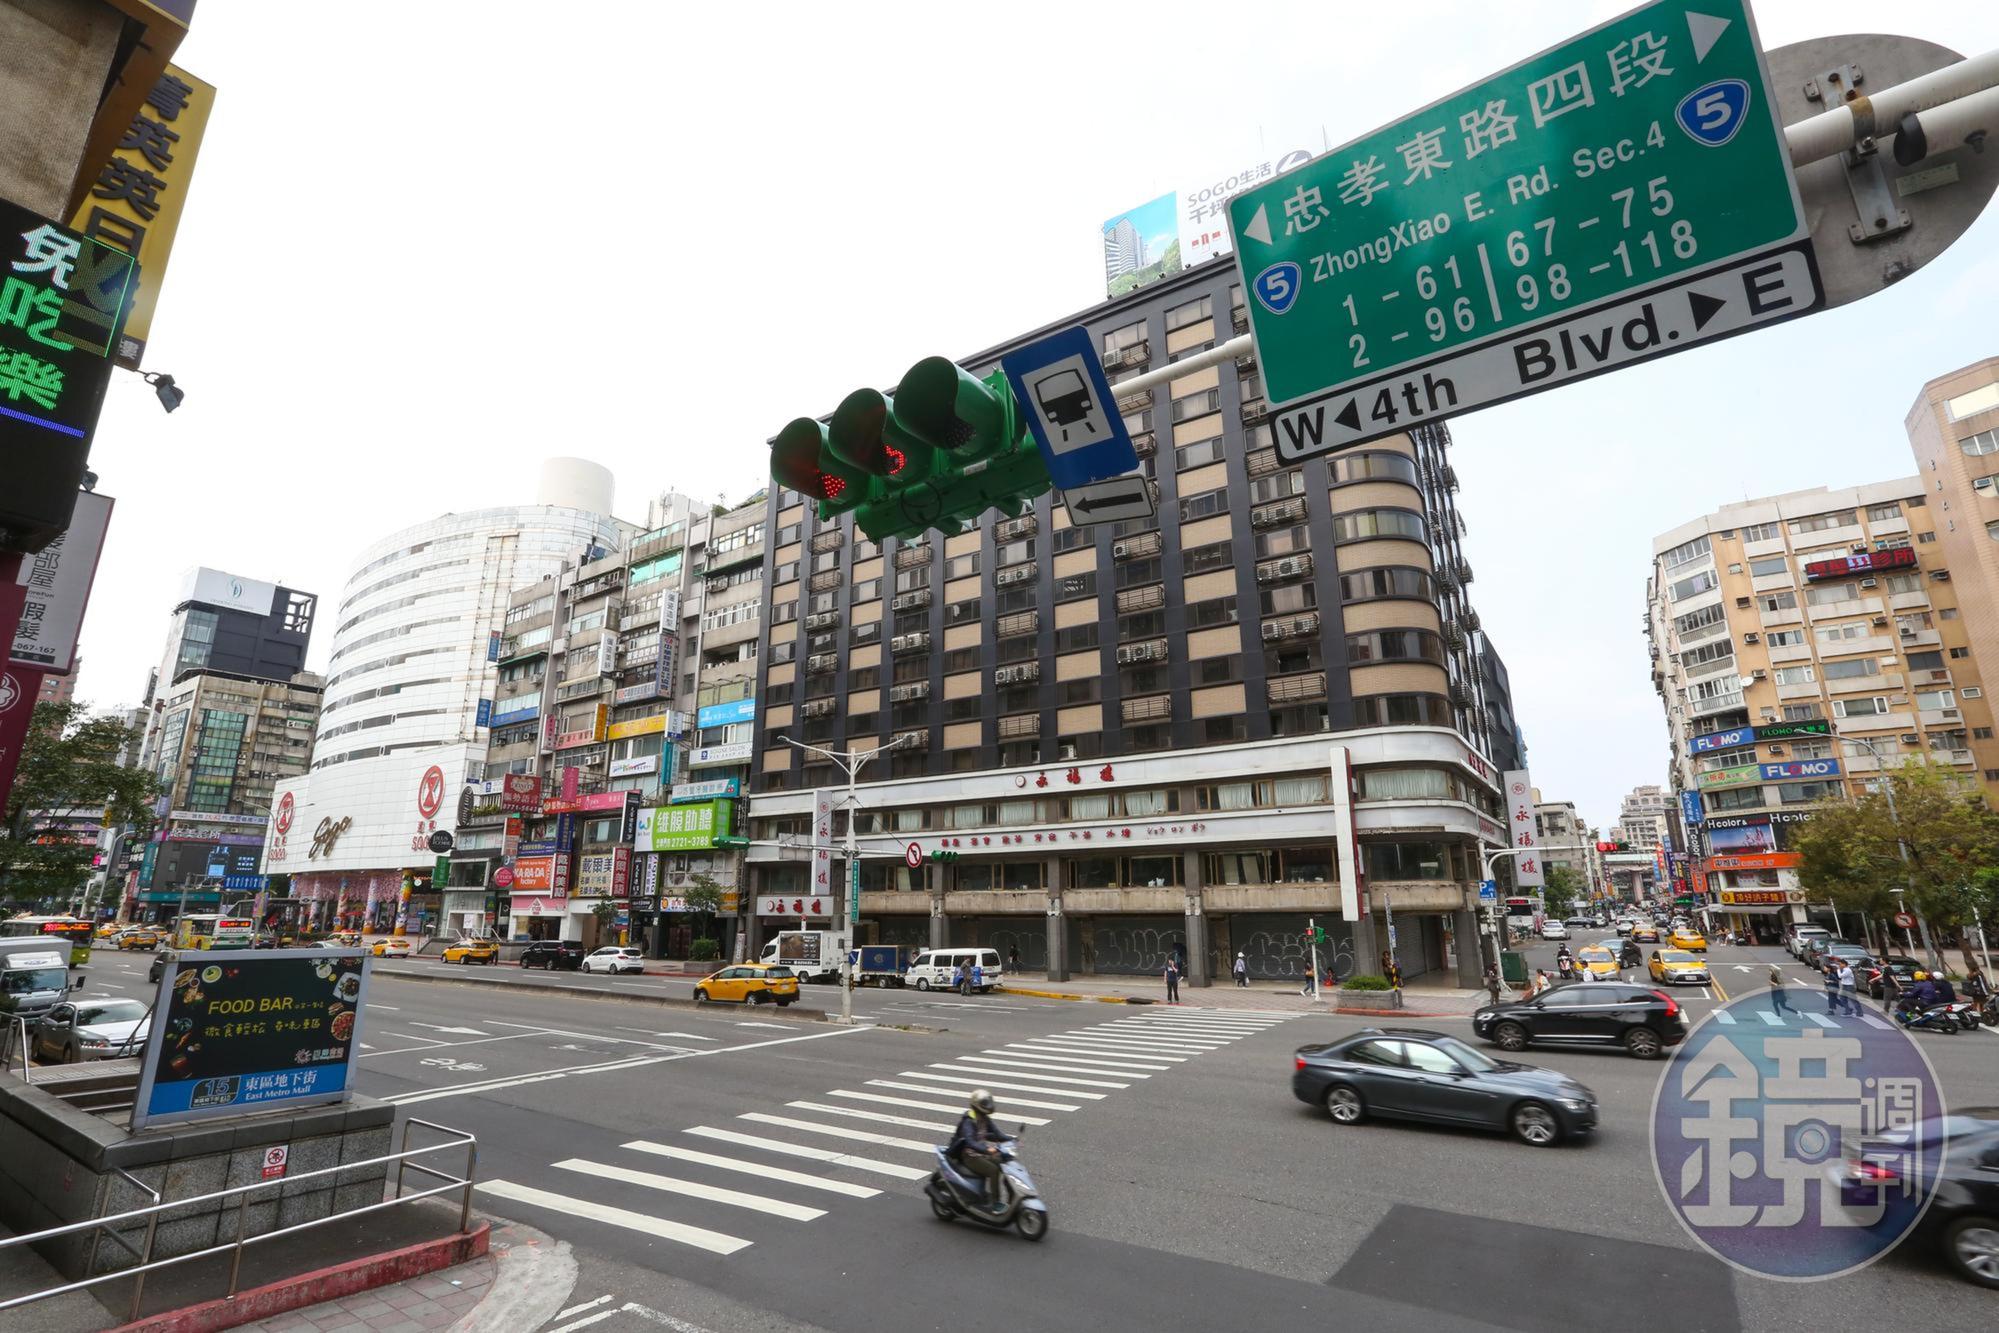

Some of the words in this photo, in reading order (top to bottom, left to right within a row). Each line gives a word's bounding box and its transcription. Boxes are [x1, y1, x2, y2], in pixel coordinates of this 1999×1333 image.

[1696, 91, 1733, 130] 5
[1283, 31, 1675, 237] 忠孝東路四段
[1309, 211, 1451, 284] ZhongXiao
[1463, 192, 1495, 223] E.
[1506, 165, 1559, 205] Rd.
[1572, 120, 1666, 178] Sec.4
[1342, 294, 1359, 326] 1
[1415, 254, 1463, 301] 61
[1506, 217, 1557, 267] 67
[1611, 176, 1675, 229] 75
[1265, 271, 1290, 301] 5
[1348, 333, 1371, 369] 2
[1424, 296, 1476, 342] 96
[1515, 263, 1572, 311] 98
[1281, 406, 1326, 451] W
[1371, 373, 1458, 425] 4th
[1513, 303, 1680, 385] Blvd.
[1742, 262, 1794, 316] E
[1697, 733, 1740, 750] FLOMO
[1766, 762, 1829, 777] FLOMO
[1515, 805, 1538, 875] 永福樓
[207, 999, 255, 1015] FOOD
[259, 997, 294, 1012] BAR
[205, 1078, 230, 1096] 15
[245, 1069, 318, 1091] 東區地下街
[245, 1092, 263, 1102] East
[264, 1088, 291, 1098] Metro
[291, 1085, 311, 1095] Mall
